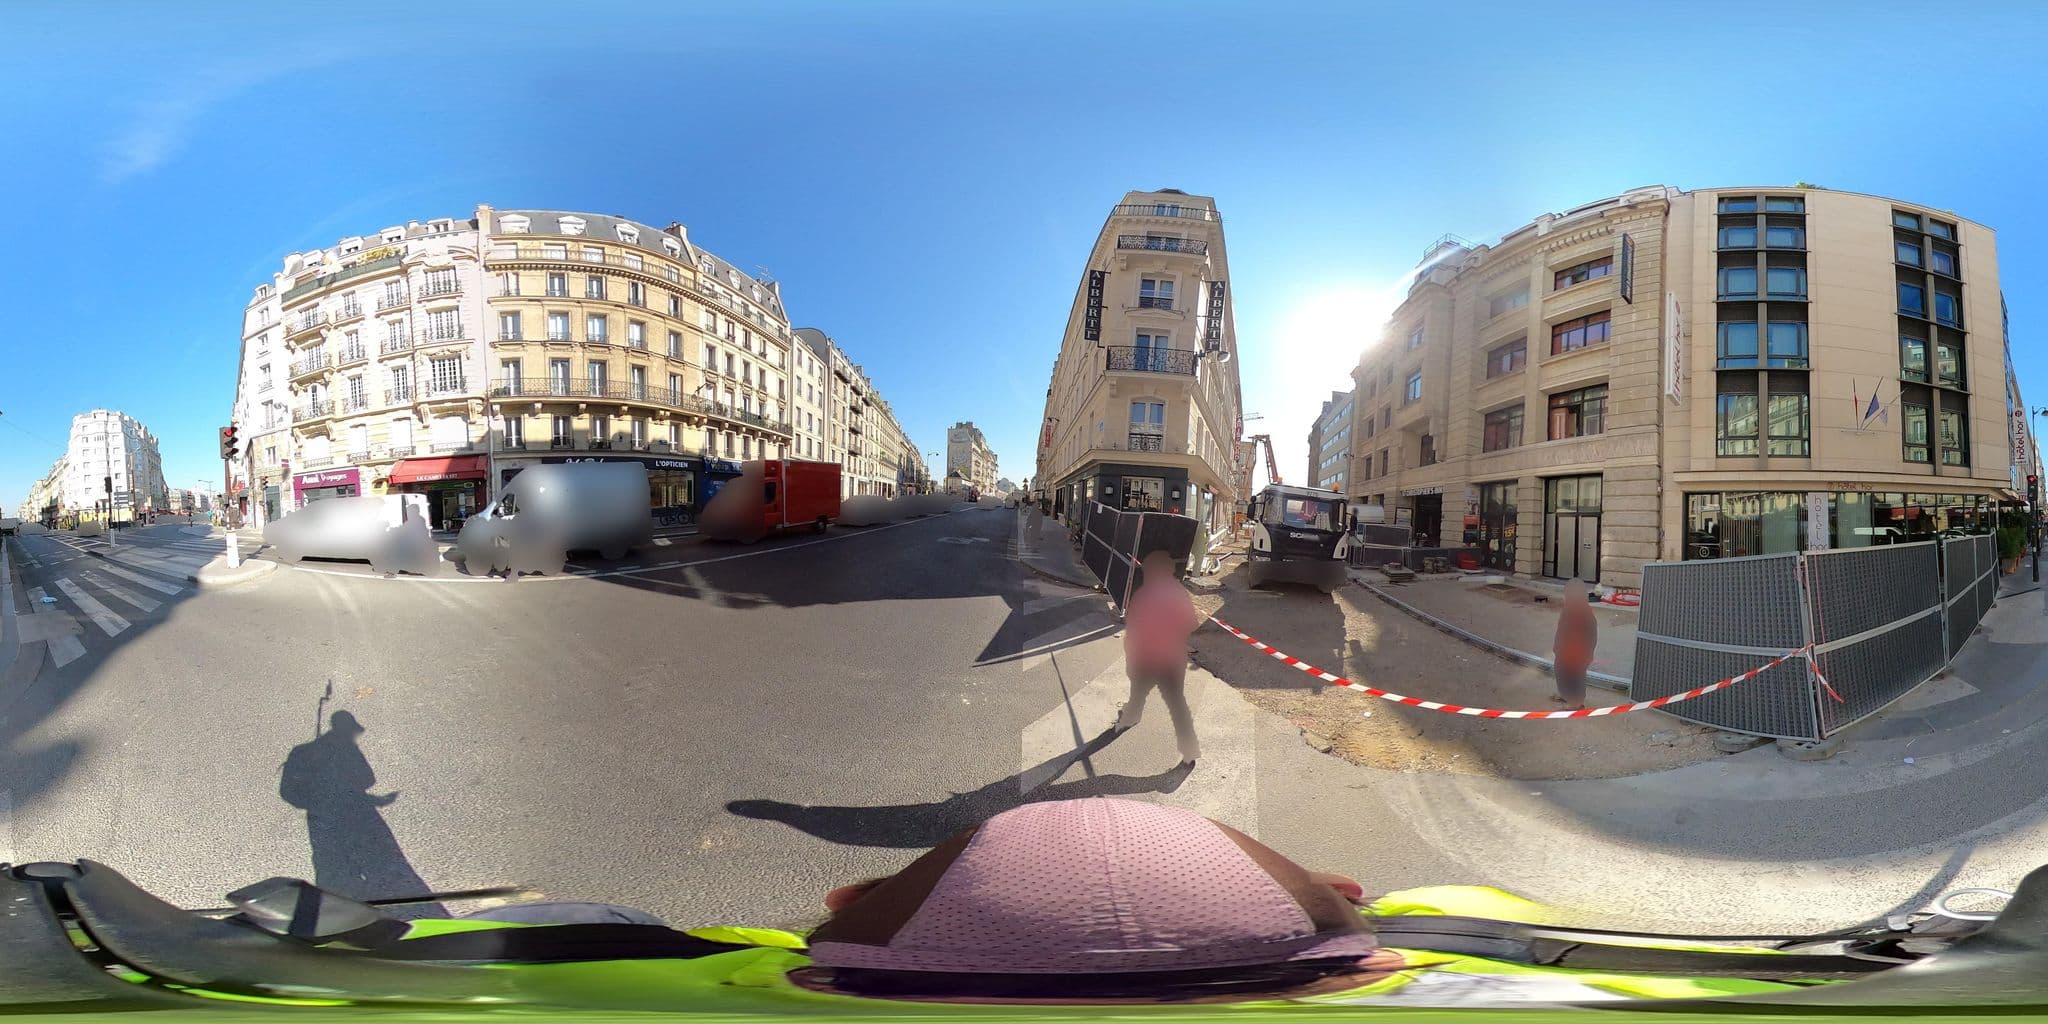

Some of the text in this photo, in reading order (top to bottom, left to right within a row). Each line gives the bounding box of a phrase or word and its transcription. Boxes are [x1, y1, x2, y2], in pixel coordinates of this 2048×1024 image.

[1088, 271, 1101, 327] ALBERT
[1209, 281, 1224, 338] ALBERT
[655, 460, 689, 468] L'OPTICIEN
[2016, 420, 2025, 460] hôtel hor
